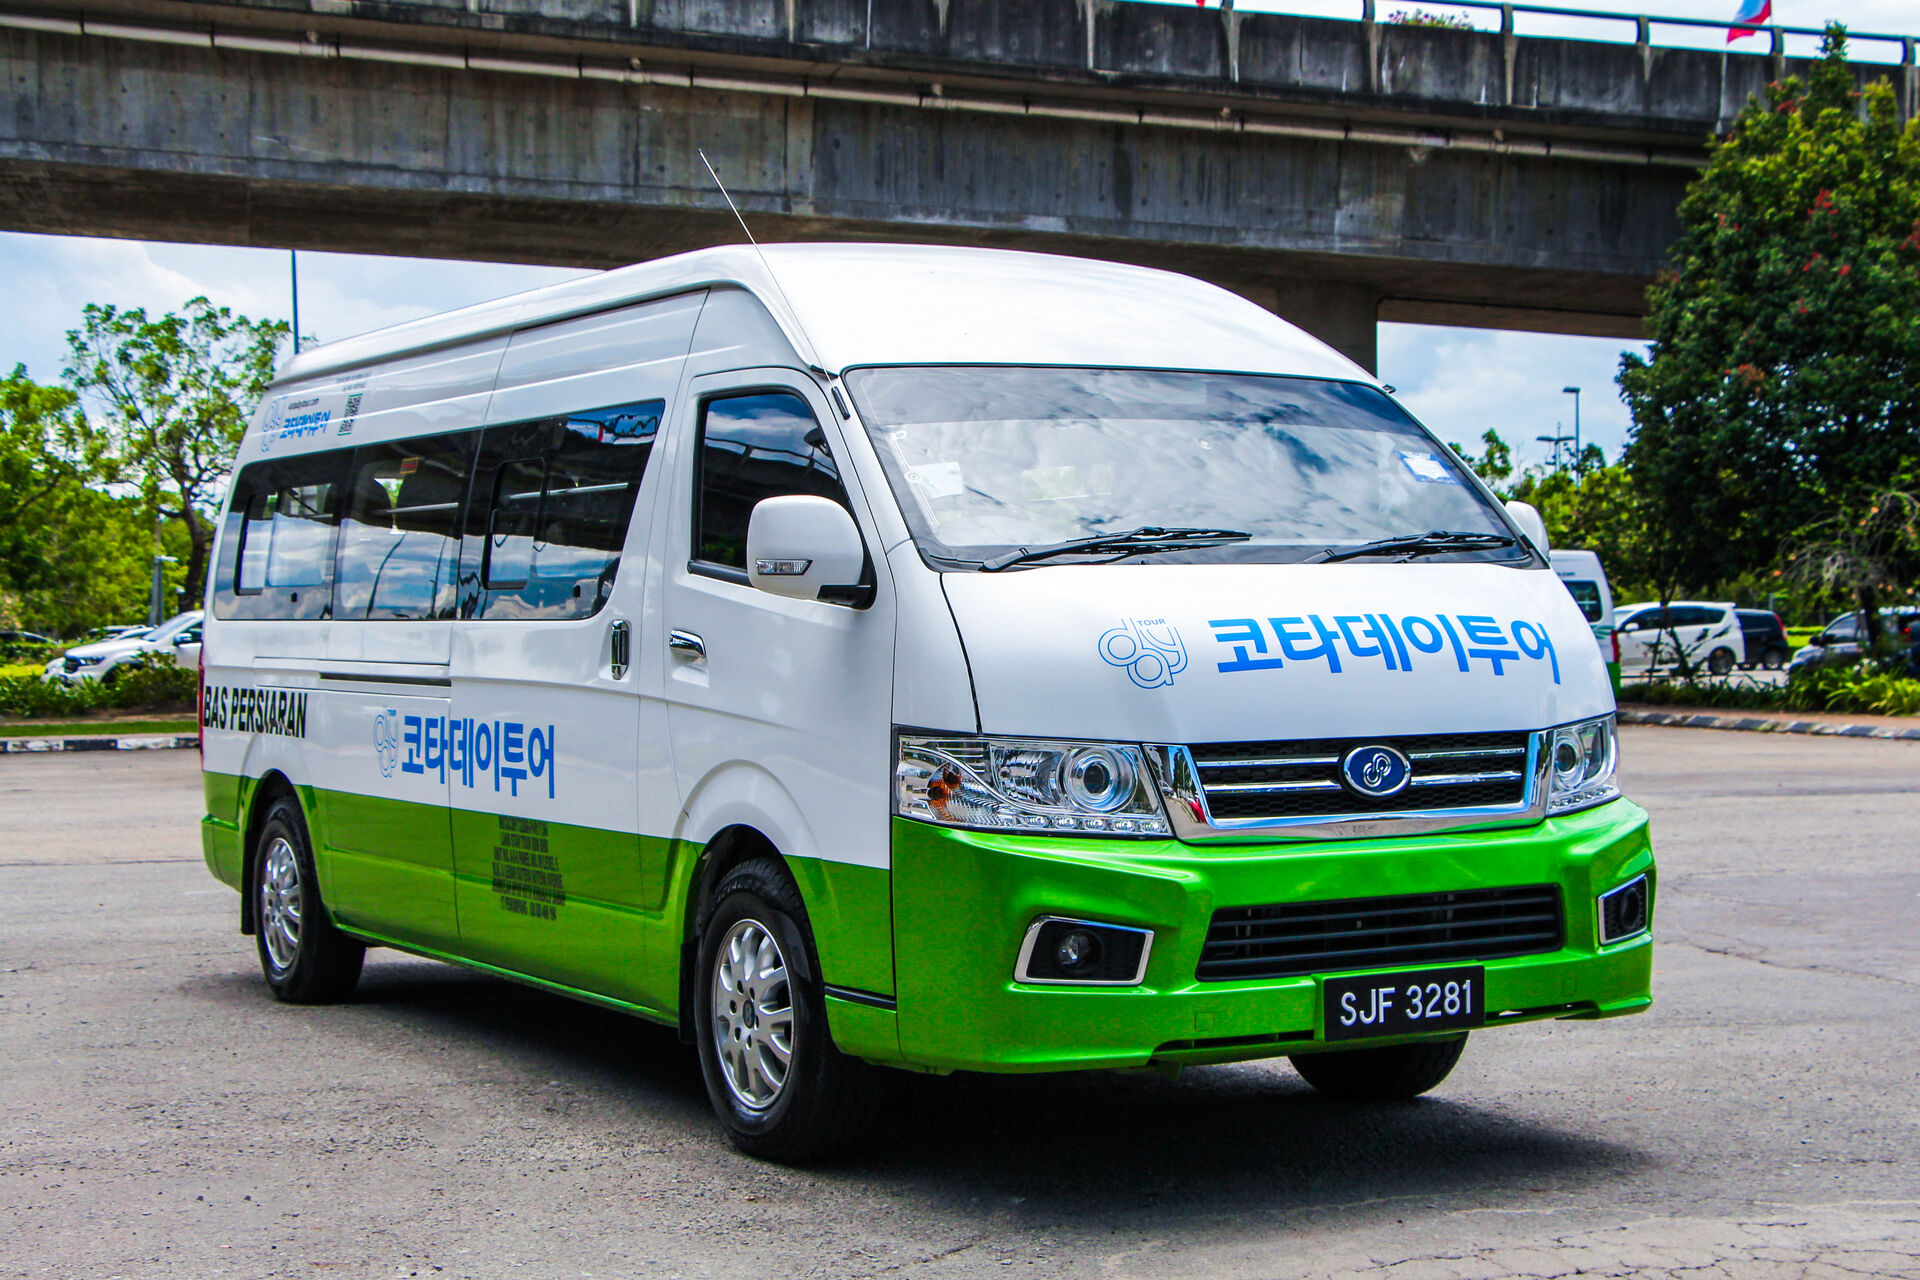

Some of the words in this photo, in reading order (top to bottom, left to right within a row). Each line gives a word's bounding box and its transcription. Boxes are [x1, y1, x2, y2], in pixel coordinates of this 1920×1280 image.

[1137, 618, 1166, 627] TOUR
[1207, 613, 1561, 685] 코타데이투어
[203, 685, 228, 730] BAS
[230, 687, 308, 739] PERSIARAN
[401, 714, 555, 800] 코타데이투어
[1340, 986, 1396, 1027] SJF
[1405, 979, 1472, 1020] 3281
